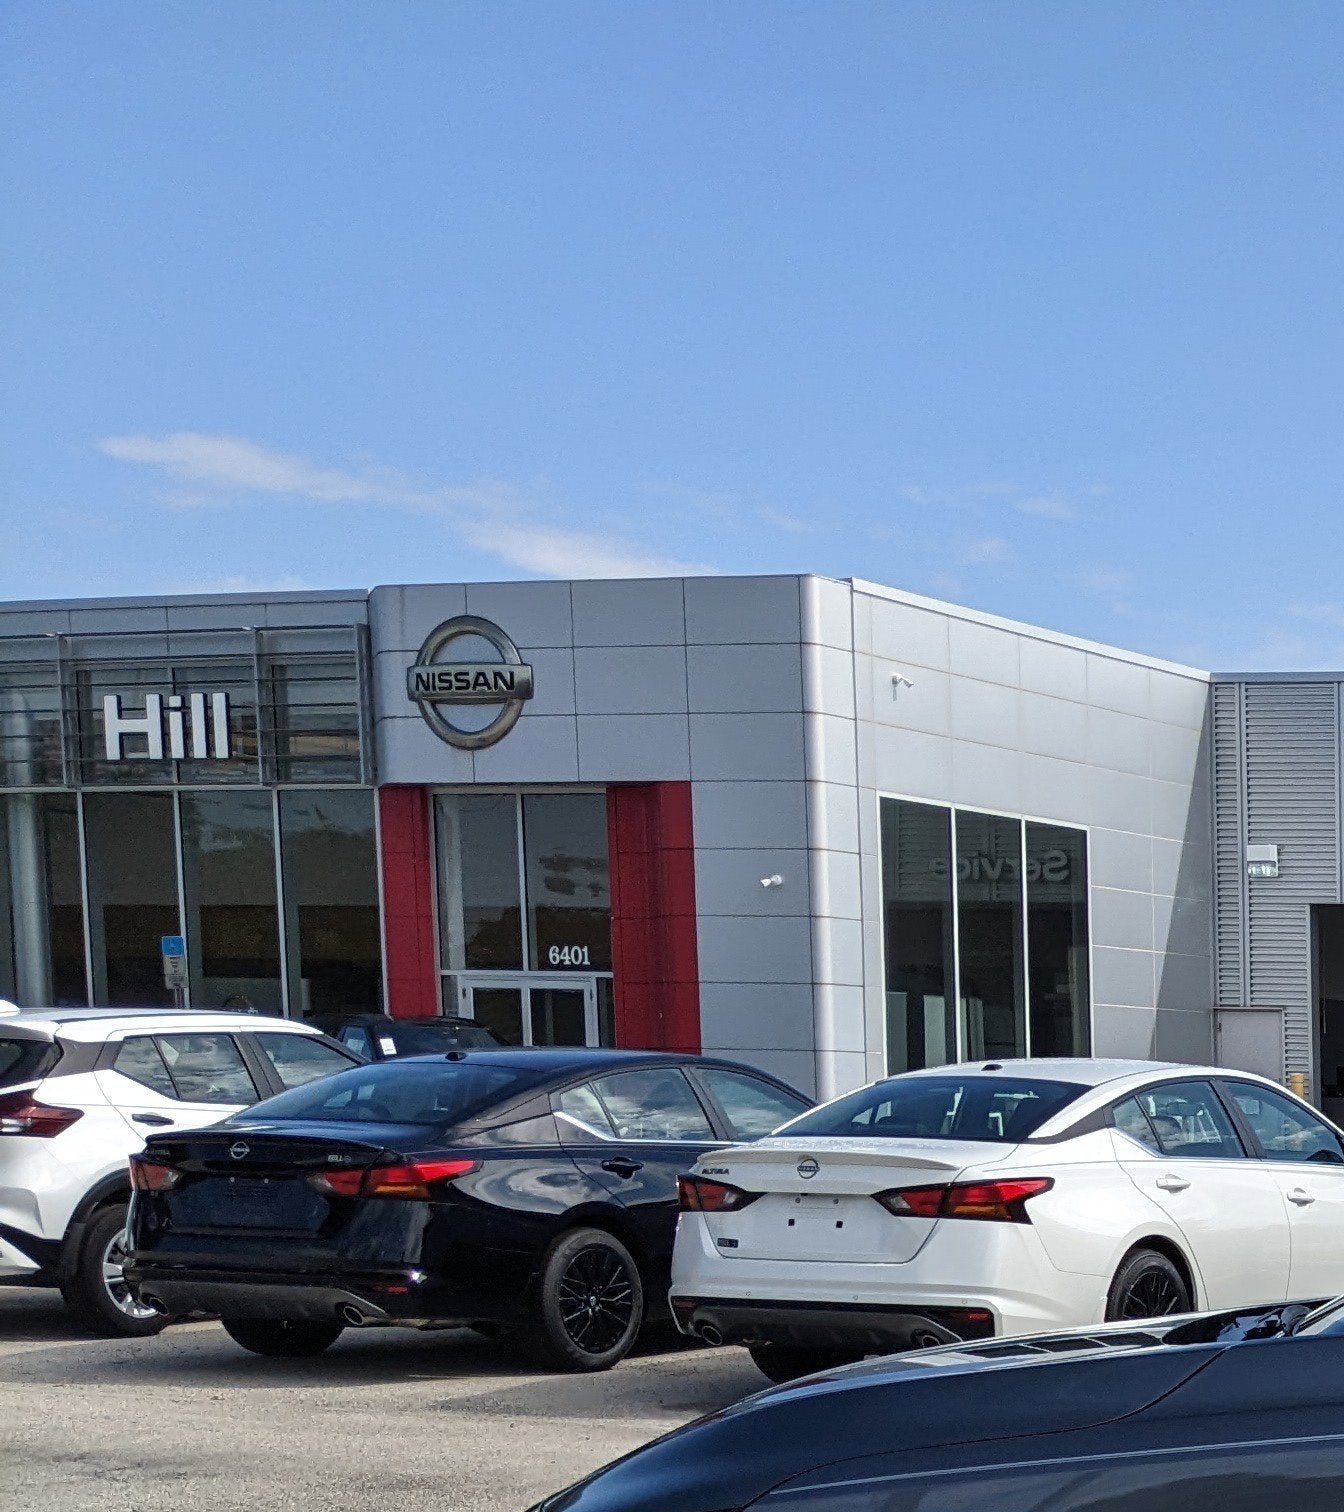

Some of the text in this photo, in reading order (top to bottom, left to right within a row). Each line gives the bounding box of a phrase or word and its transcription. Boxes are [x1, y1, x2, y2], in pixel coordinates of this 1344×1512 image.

[415, 671, 516, 693] NISSAN
[104, 692, 231, 760] Hill
[548, 945, 591, 965] 6401
